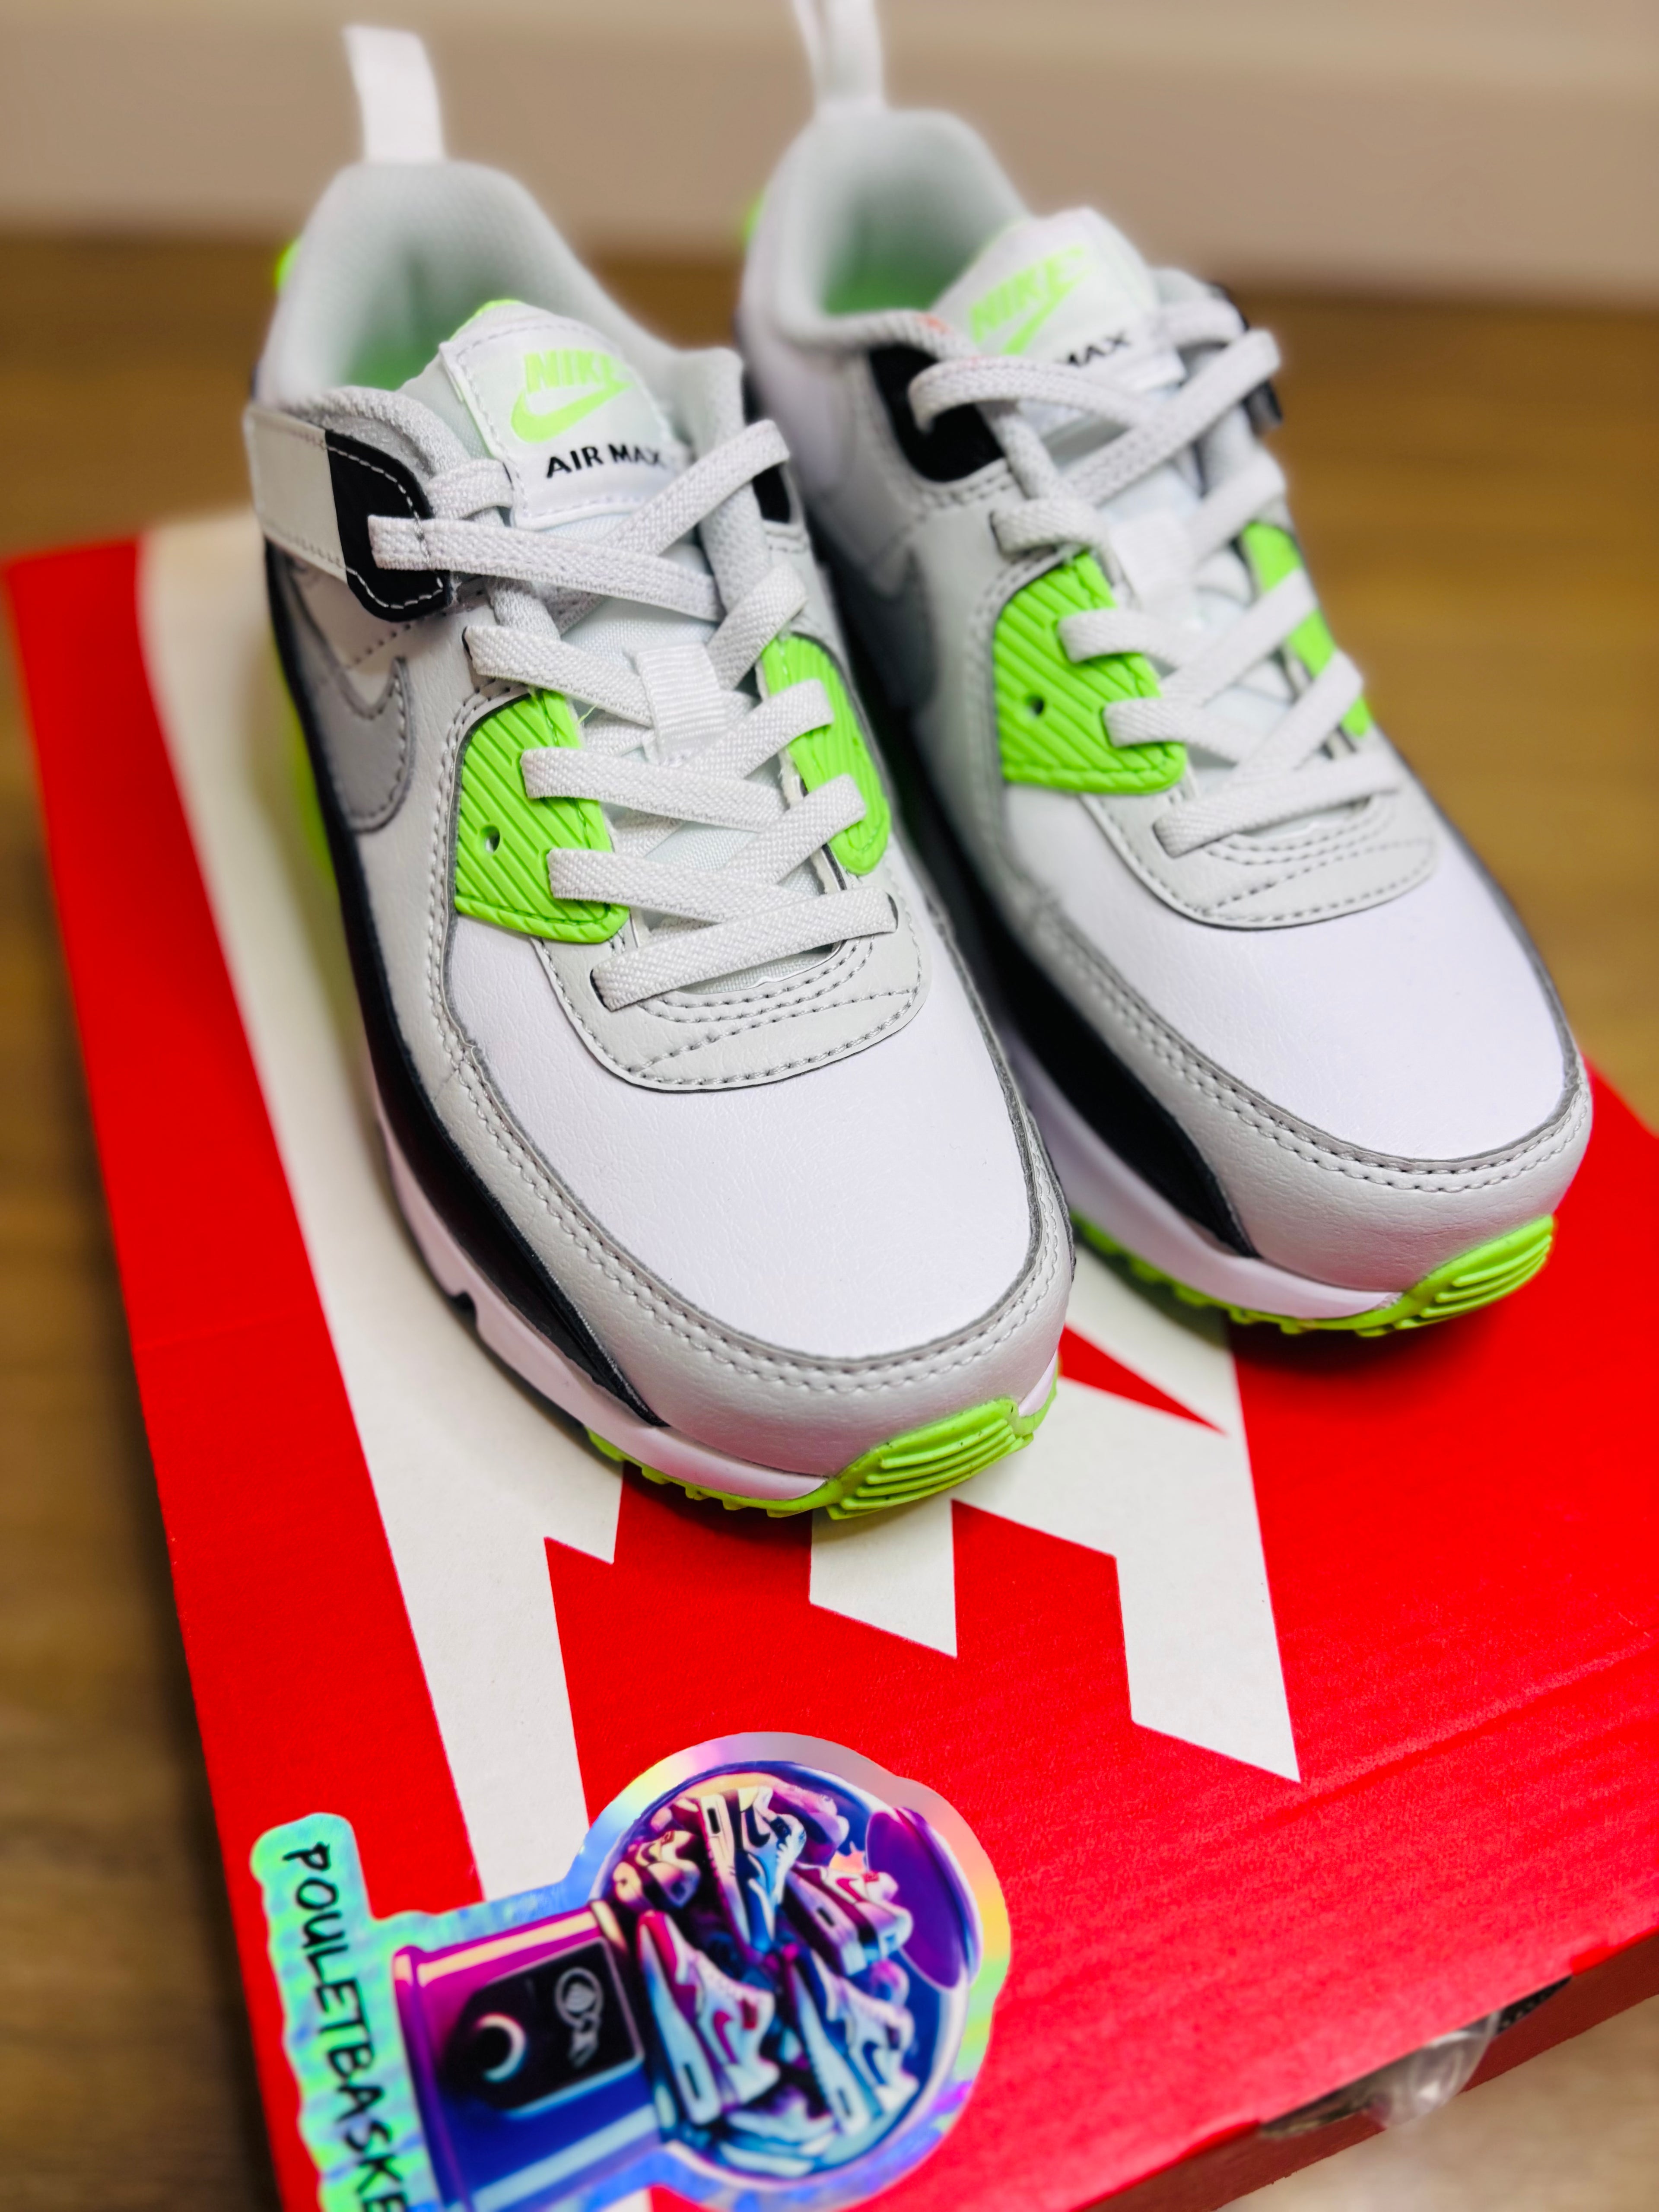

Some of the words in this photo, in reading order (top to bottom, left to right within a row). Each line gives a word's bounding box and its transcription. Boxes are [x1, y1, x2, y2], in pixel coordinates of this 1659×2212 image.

[524, 350, 626, 393] NIKE
[546, 445, 604, 478] AIR
[608, 443, 664, 467] MAX
